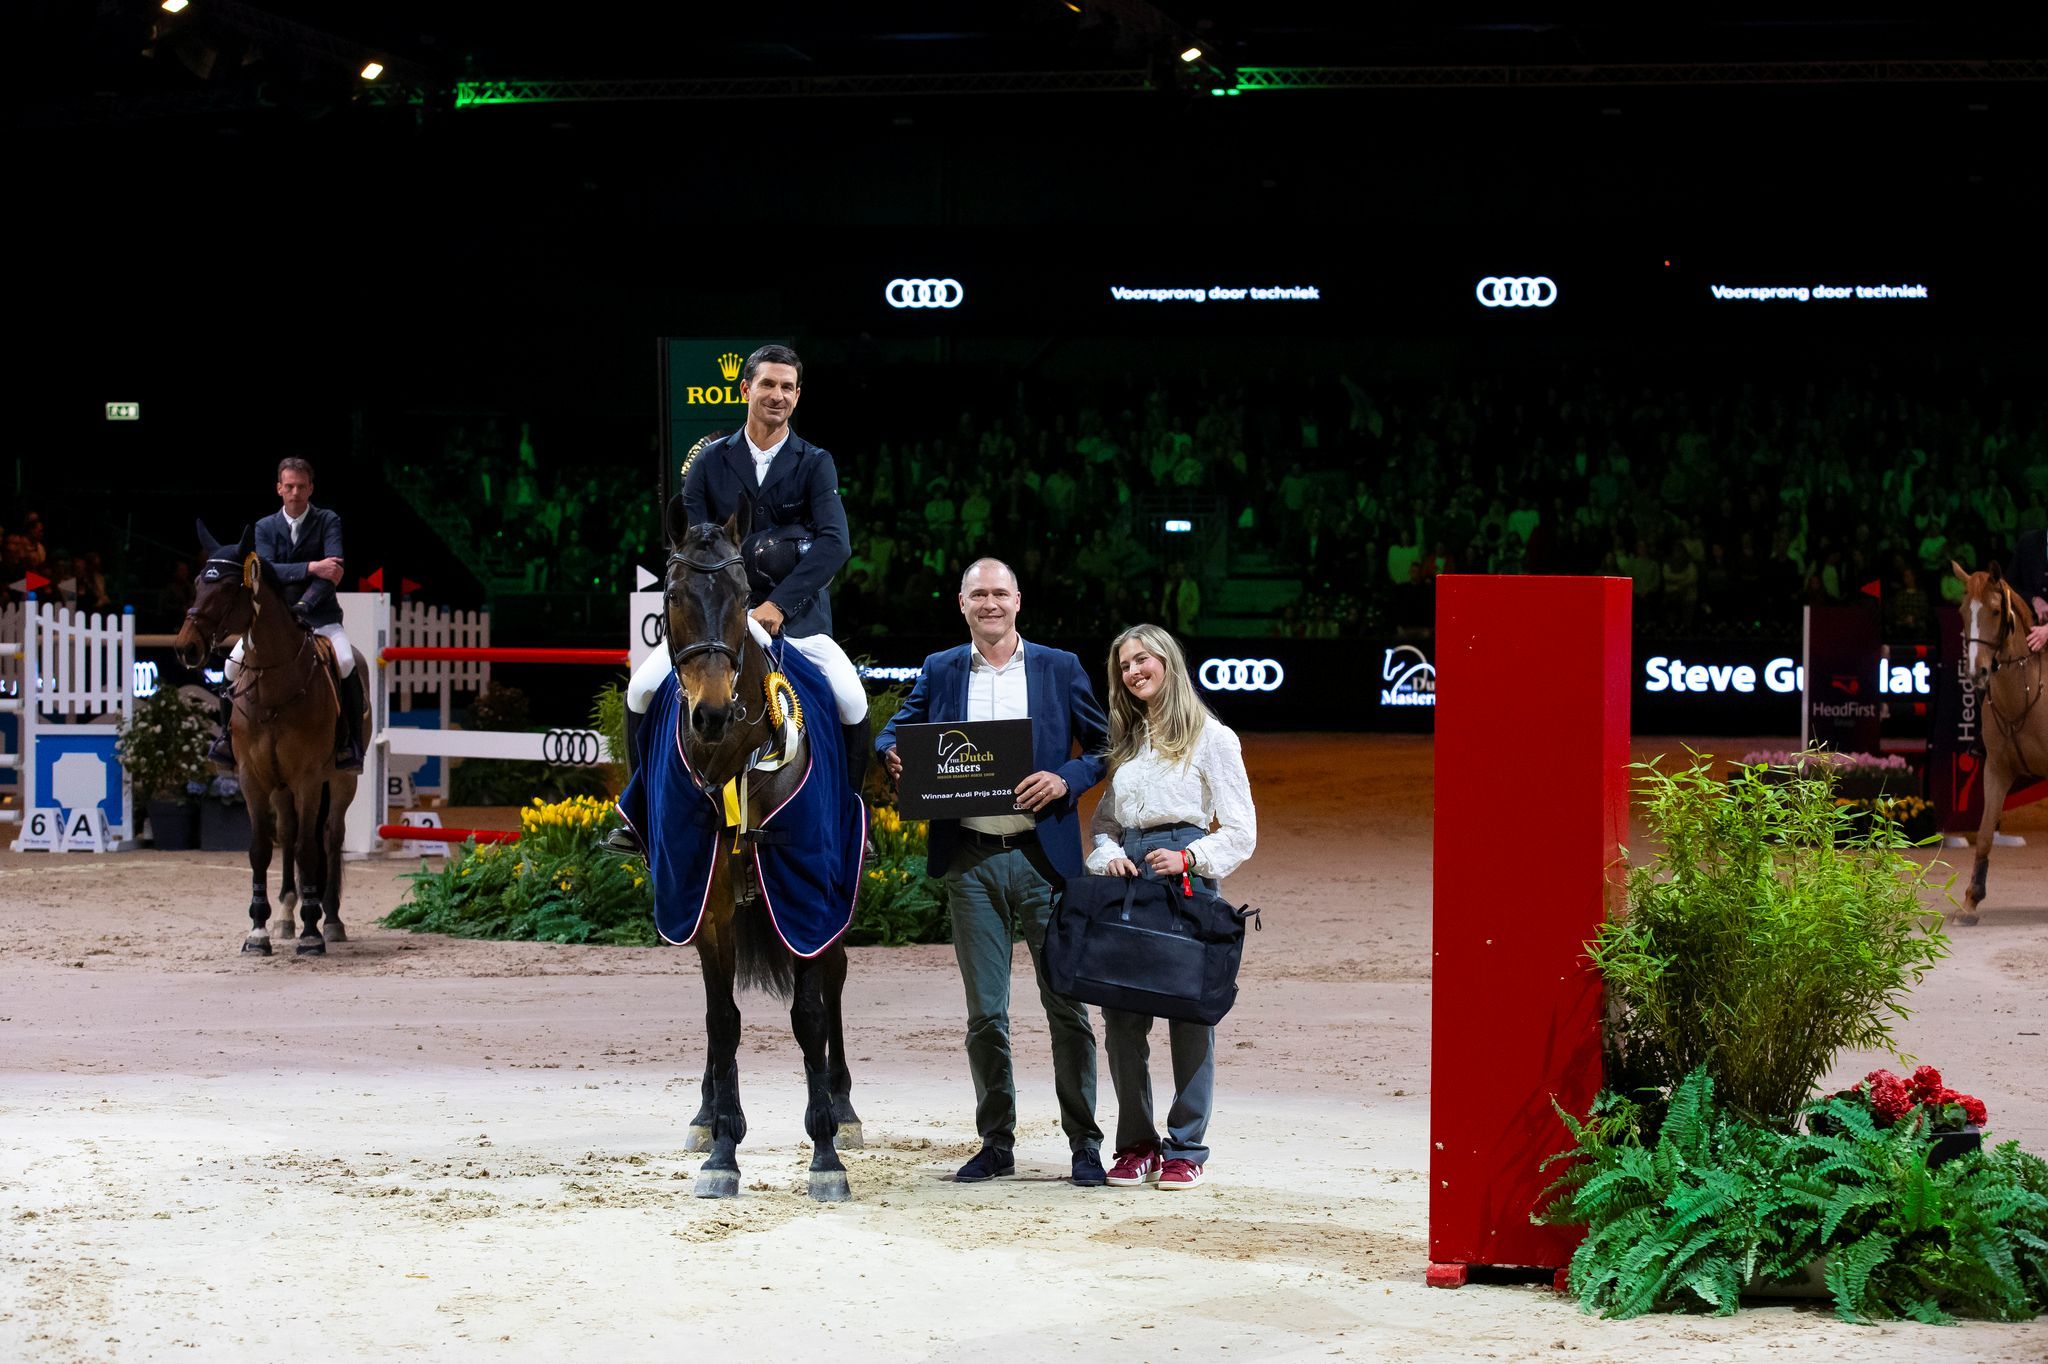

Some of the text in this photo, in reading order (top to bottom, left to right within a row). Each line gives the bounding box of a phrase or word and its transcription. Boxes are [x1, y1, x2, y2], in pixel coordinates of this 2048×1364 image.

[1111, 286, 1320, 302] Voorsprong door techniek
[1711, 284, 1929, 301] Voorsprong door techniek
[687, 386, 749, 404] ROL
[1645, 656, 1756, 693] Steve
[1381, 689, 1436, 705] Master
[1812, 701, 1876, 717] HeadFirst
[960, 751, 994, 763] Dutch
[937, 763, 981, 774] Masters
[388, 777, 403, 795] B
[974, 790, 990, 798] Prijs
[992, 788, 1012, 796] 2026
[31, 814, 46, 836] 6
[71, 814, 92, 836] A
